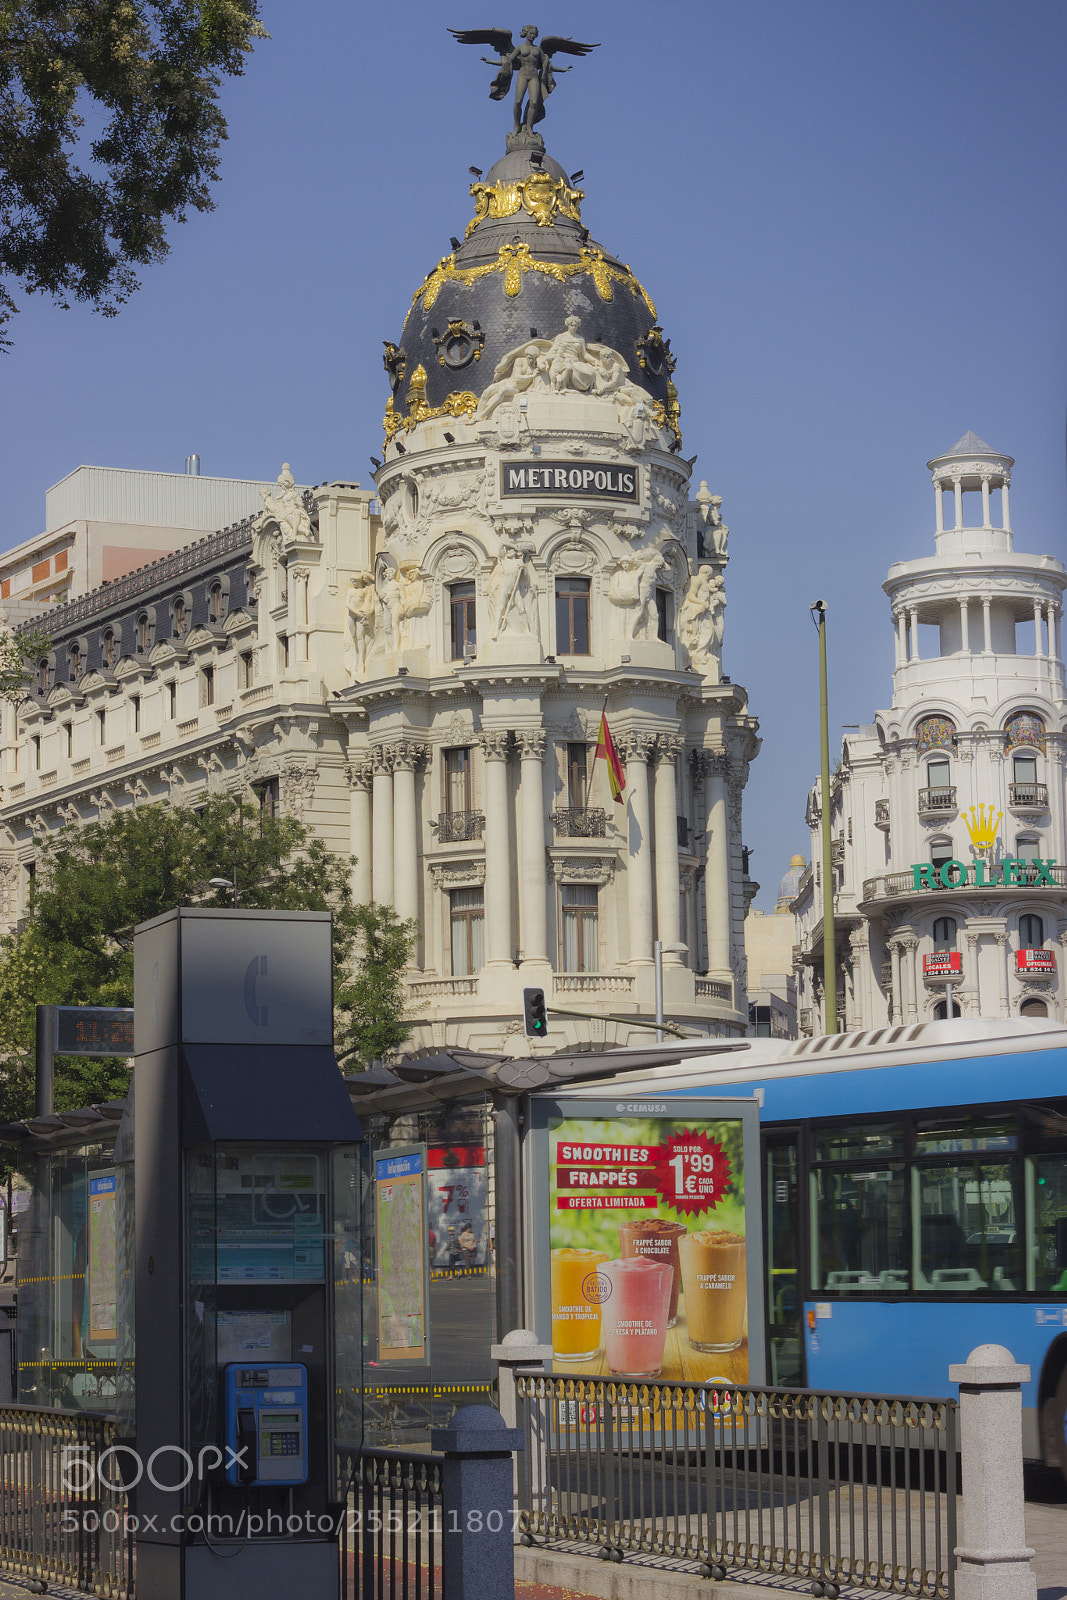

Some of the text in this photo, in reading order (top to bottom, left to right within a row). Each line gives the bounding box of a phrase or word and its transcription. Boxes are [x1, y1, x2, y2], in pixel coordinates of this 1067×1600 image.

[509, 468, 634, 493] METROPOLIS
[910, 858, 1060, 891] ROLEX
[627, 1104, 668, 1113] CEMUSA
[562, 1146, 650, 1163] SMOOTHIES
[569, 1167, 639, 1186] FRAPPÉS
[698, 1177, 714, 1185] CADA
[698, 1185, 714, 1194] UNO
[569, 1197, 646, 1208] OFERTA LIMITADA
[632, 1237, 672, 1247] FRAPPÉ SABOR
[696, 1273, 736, 1282] FRAPPÉ SABOR
[705, 1282, 732, 1290] CARAMELO
[558, 1305, 592, 1313] SMOOTHIE DE
[552, 1313, 570, 1321] MANGO
[575, 1313, 600, 1321] TROPICAL
[616, 1320, 652, 1328] SMOOTHIE DE
[612, 1328, 629, 1336] FRESA
[629, 1328, 634, 1336] Y
